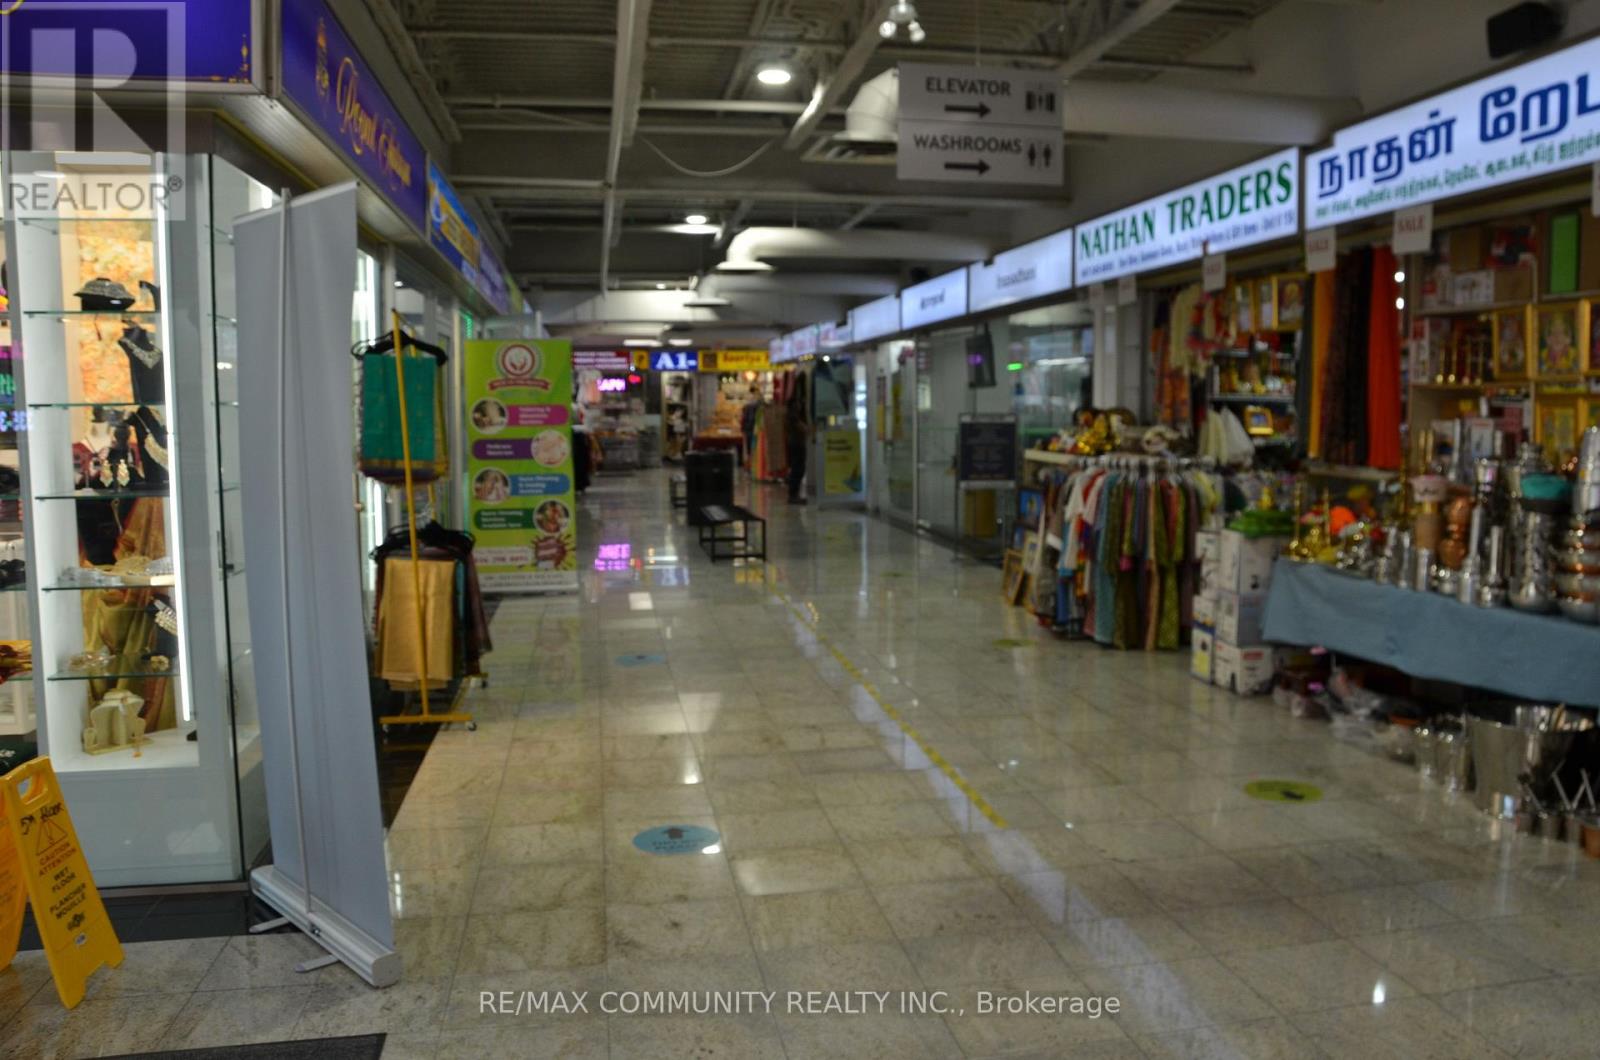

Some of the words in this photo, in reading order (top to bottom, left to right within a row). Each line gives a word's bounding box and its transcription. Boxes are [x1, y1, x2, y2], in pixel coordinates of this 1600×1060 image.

[925, 76, 1012, 97] ELEVATOR
[913, 133, 1022, 155] WASHROOMS
[1318, 109, 1457, 199] நாதன்
[1080, 208, 1157, 261] NATHAN
[1166, 161, 1293, 235] TRADERS
[52, 872, 76, 893] FLOOR
[54, 866, 69, 881] WET
